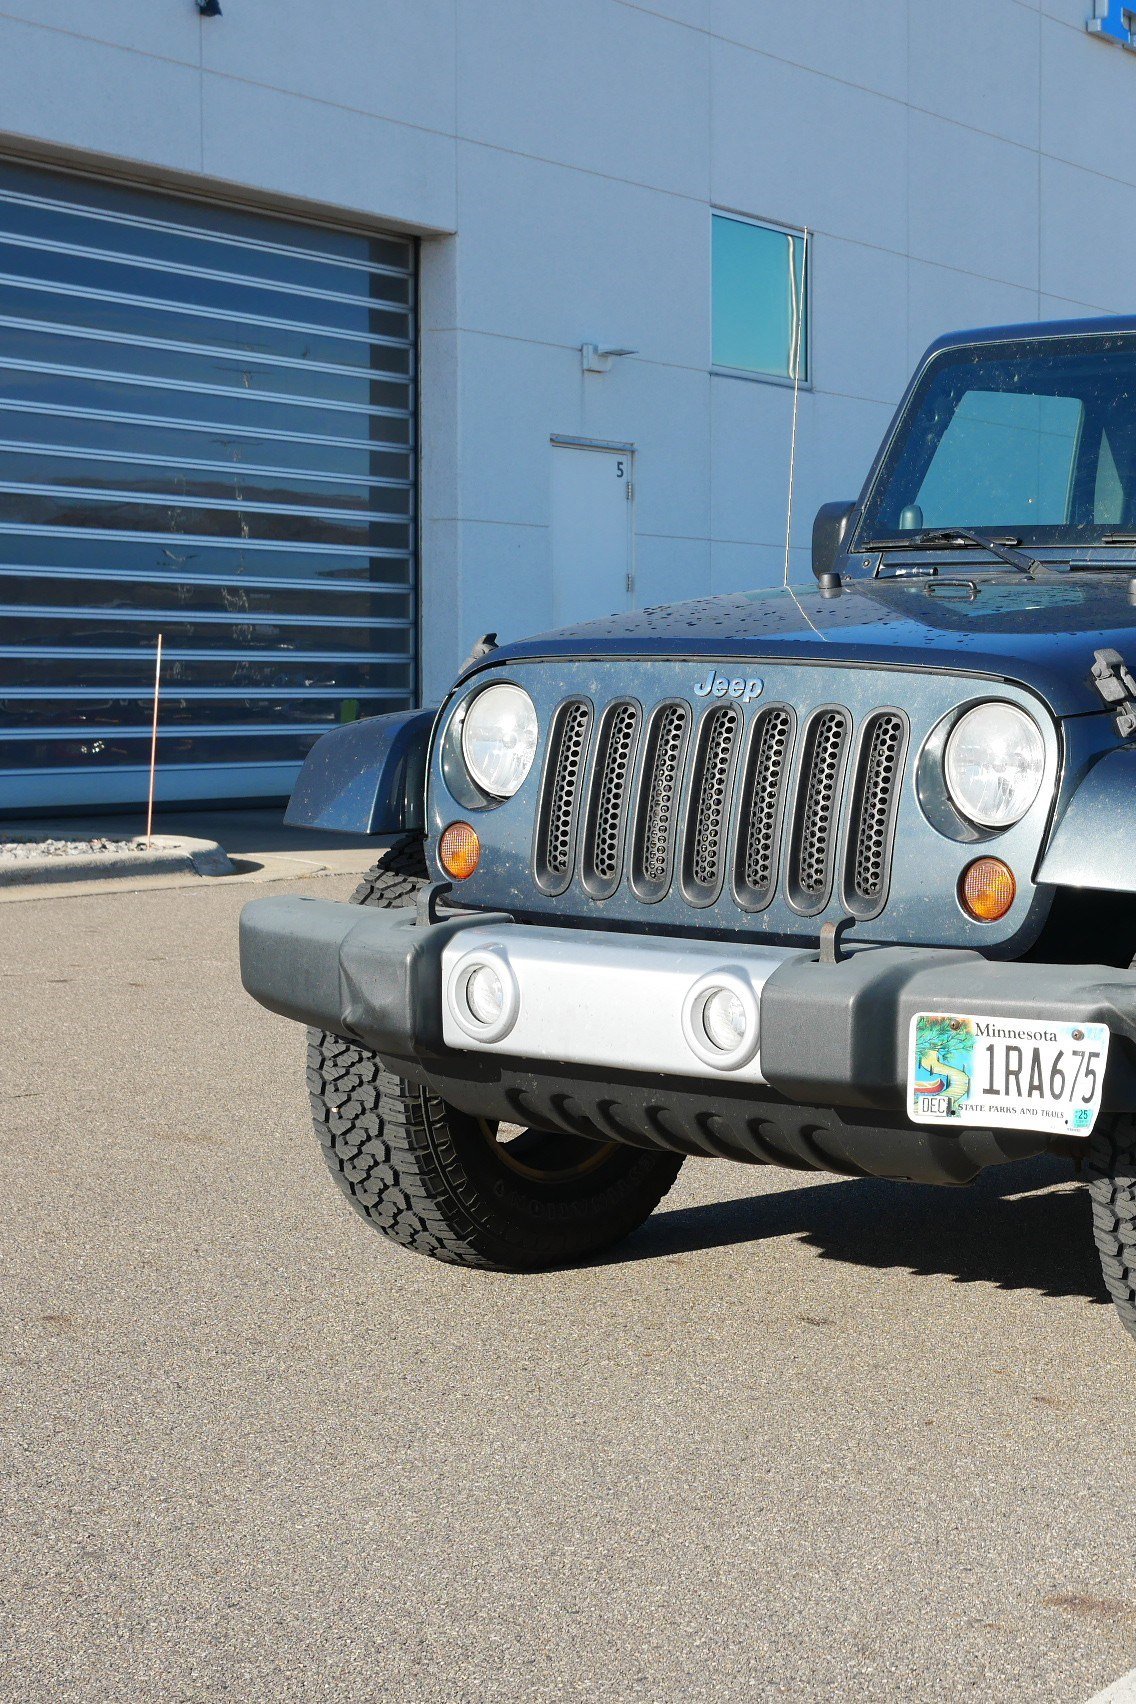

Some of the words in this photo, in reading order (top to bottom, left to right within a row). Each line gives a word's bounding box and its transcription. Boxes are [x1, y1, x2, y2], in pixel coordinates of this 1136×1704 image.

[616, 461, 624, 478] 5
[693, 670, 764, 703] Jeep
[975, 1022, 1057, 1042] Minnesota
[982, 1043, 1101, 1104] 1RA675
[922, 1097, 945, 1114] DEC
[957, 1103, 986, 1112] STATE
[988, 1105, 1018, 1115] PARKS
[1019, 1107, 1038, 1117] AND
[1078, 1109, 1088, 1120] 25
